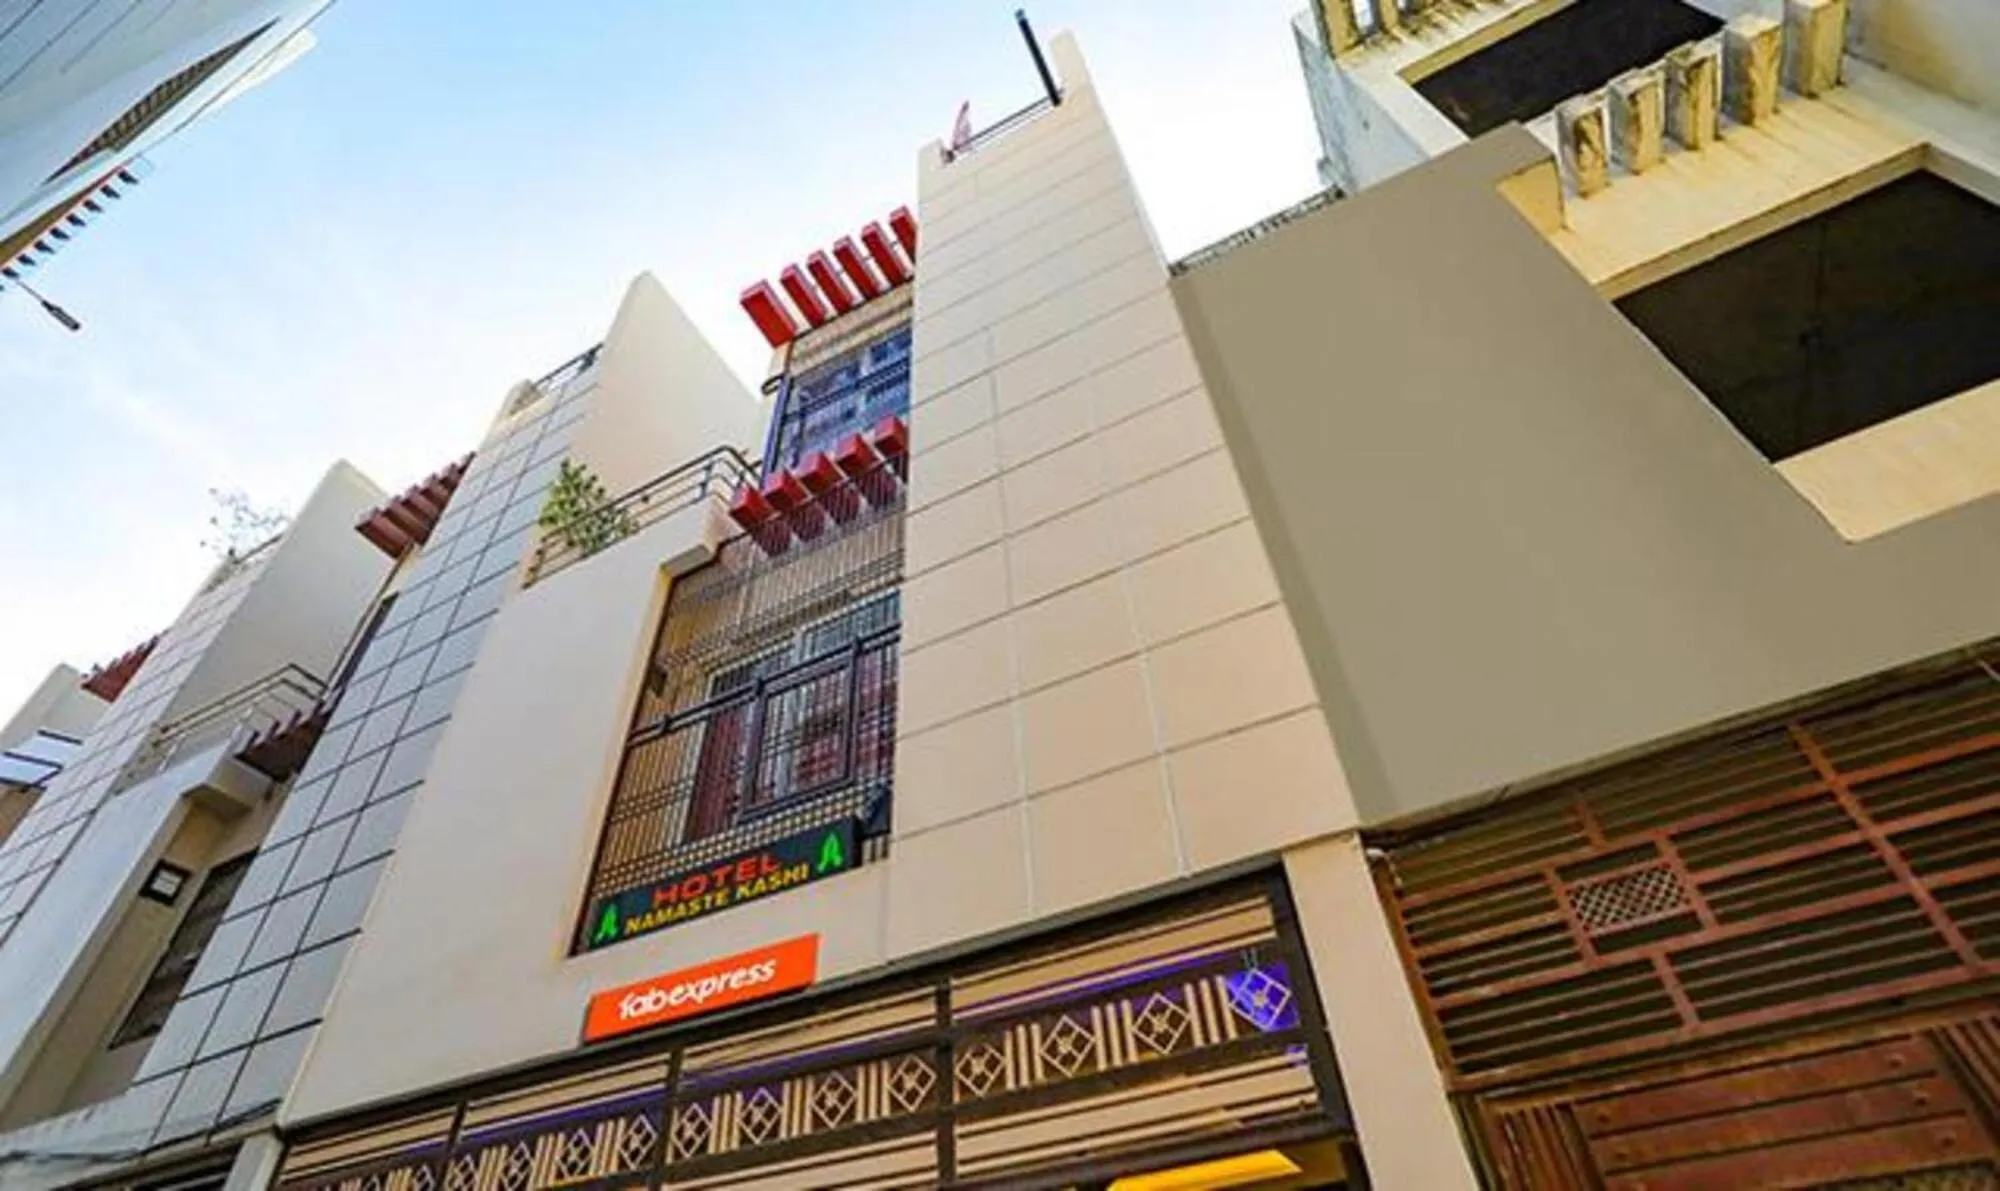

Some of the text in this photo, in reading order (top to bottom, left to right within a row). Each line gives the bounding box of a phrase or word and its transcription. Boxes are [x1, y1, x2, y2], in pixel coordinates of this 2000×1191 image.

[624, 863, 810, 934] NAMASTE KASHI
[652, 853, 780, 906] HOTEL
[618, 958, 777, 1020] fabexpress
